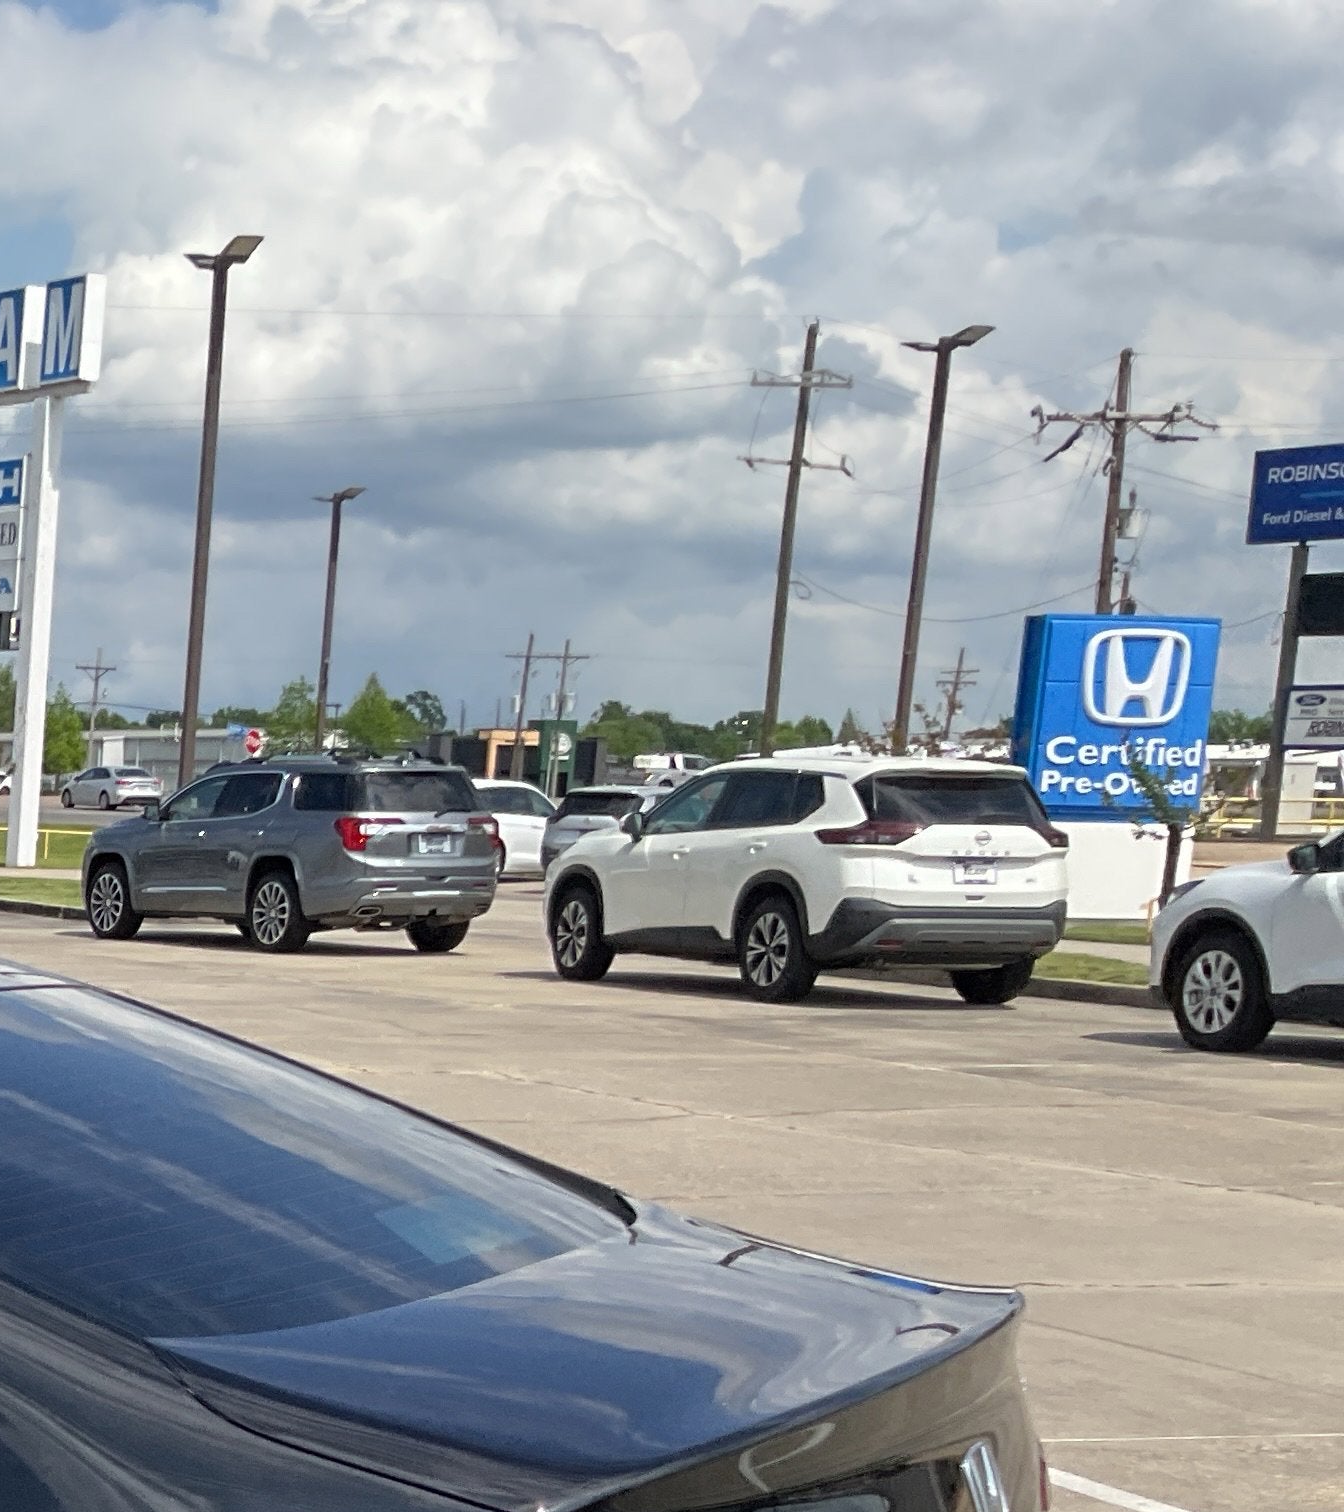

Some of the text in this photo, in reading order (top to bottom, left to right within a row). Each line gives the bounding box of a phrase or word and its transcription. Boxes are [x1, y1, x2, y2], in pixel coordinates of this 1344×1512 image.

[1267, 461, 1344, 484] ROBINS
[1262, 511, 1291, 525] Ford
[1293, 507, 1332, 523] Diesel
